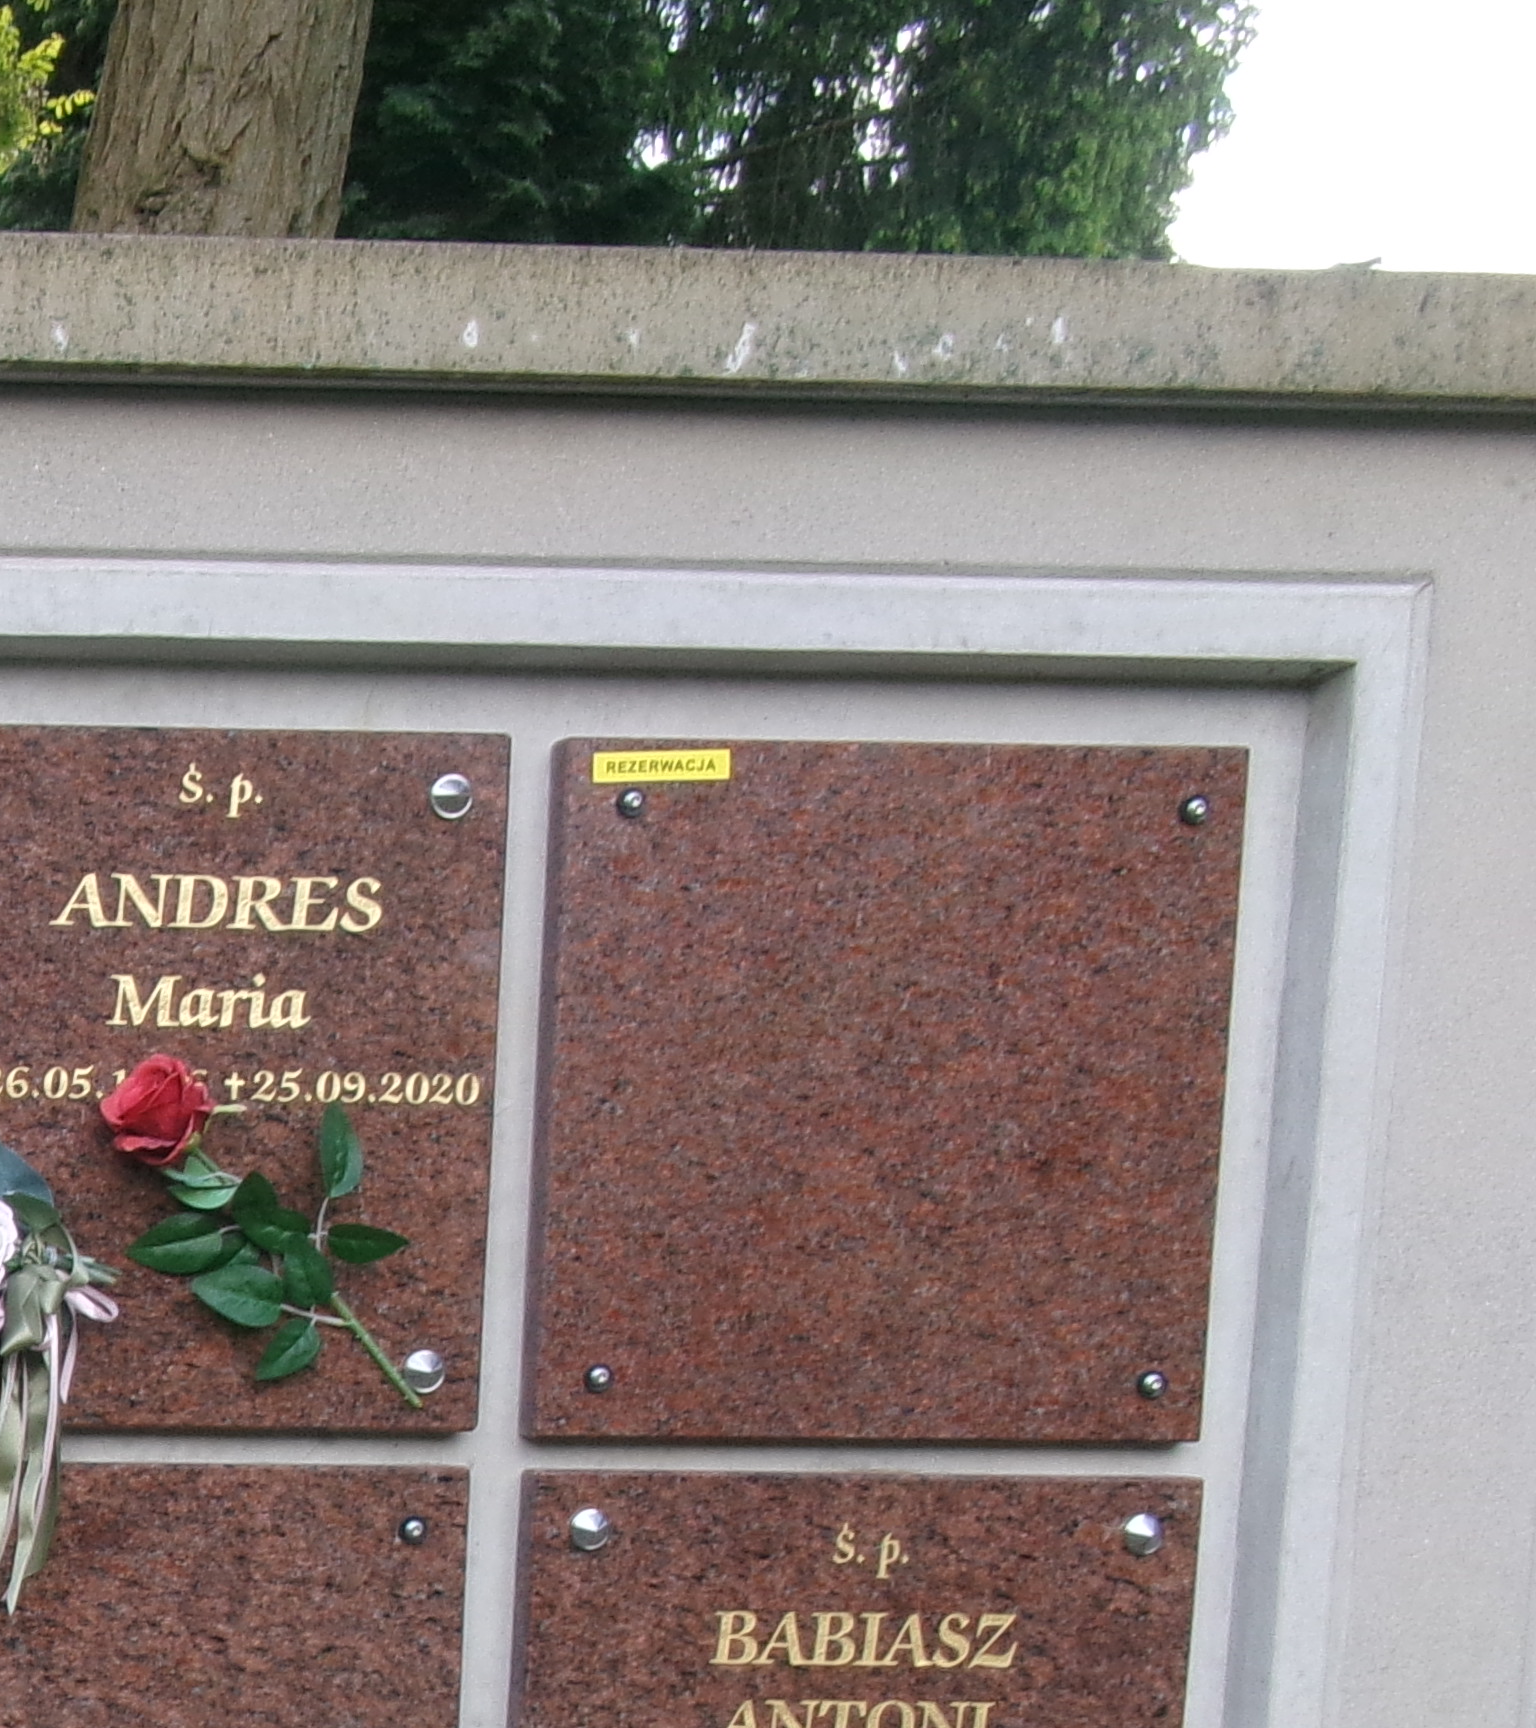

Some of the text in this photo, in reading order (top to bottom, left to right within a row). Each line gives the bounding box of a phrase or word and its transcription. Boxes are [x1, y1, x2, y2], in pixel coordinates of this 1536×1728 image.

[605, 758, 717, 775] REZERWACJA
[48, 872, 383, 933] ANDRES
[105, 972, 312, 1030] Maria
[250, 1067, 481, 1106] 25.09.2020
[709, 1610, 1018, 1669] BABIASZ
